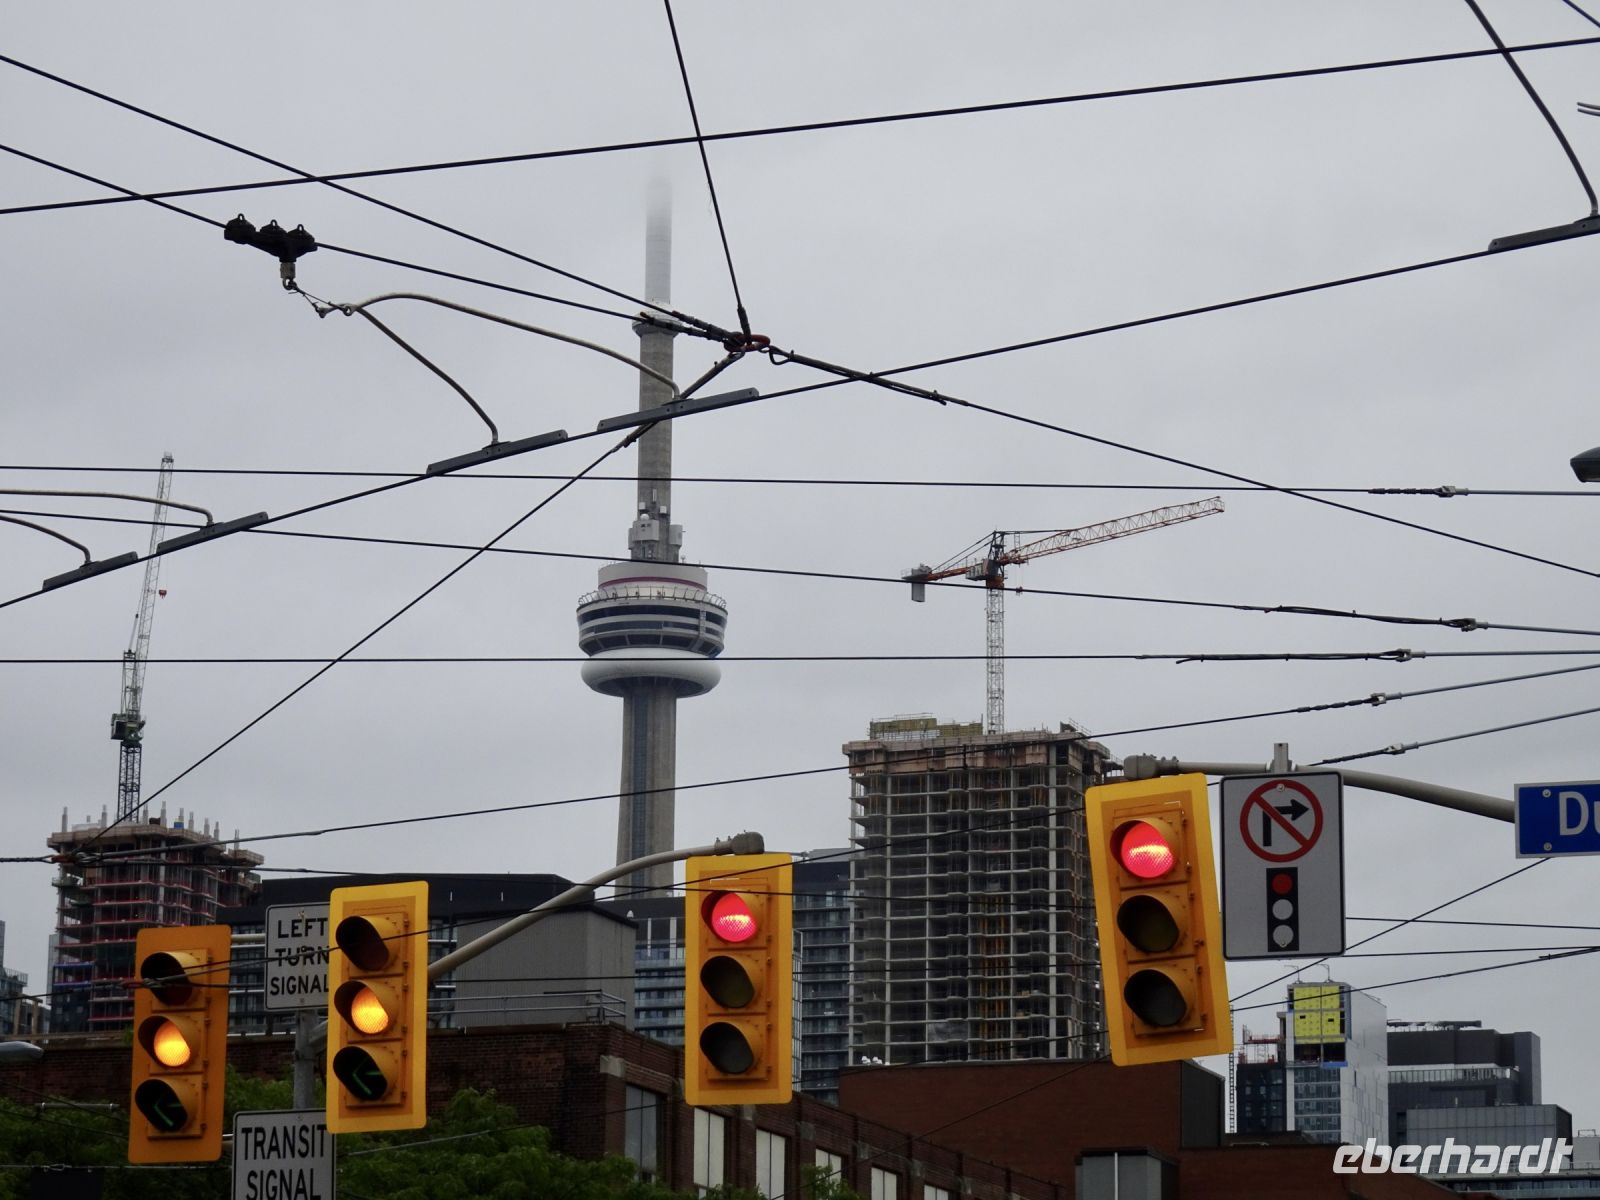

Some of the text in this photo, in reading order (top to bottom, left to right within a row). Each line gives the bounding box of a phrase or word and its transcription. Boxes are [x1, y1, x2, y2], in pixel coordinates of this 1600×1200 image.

[278, 918, 328, 938] LEFT
[275, 946, 329, 967] TURN
[270, 974, 329, 996] SIGNAL
[241, 1124, 327, 1160] TRANSIT
[246, 1168, 321, 1200] SIGNAL
